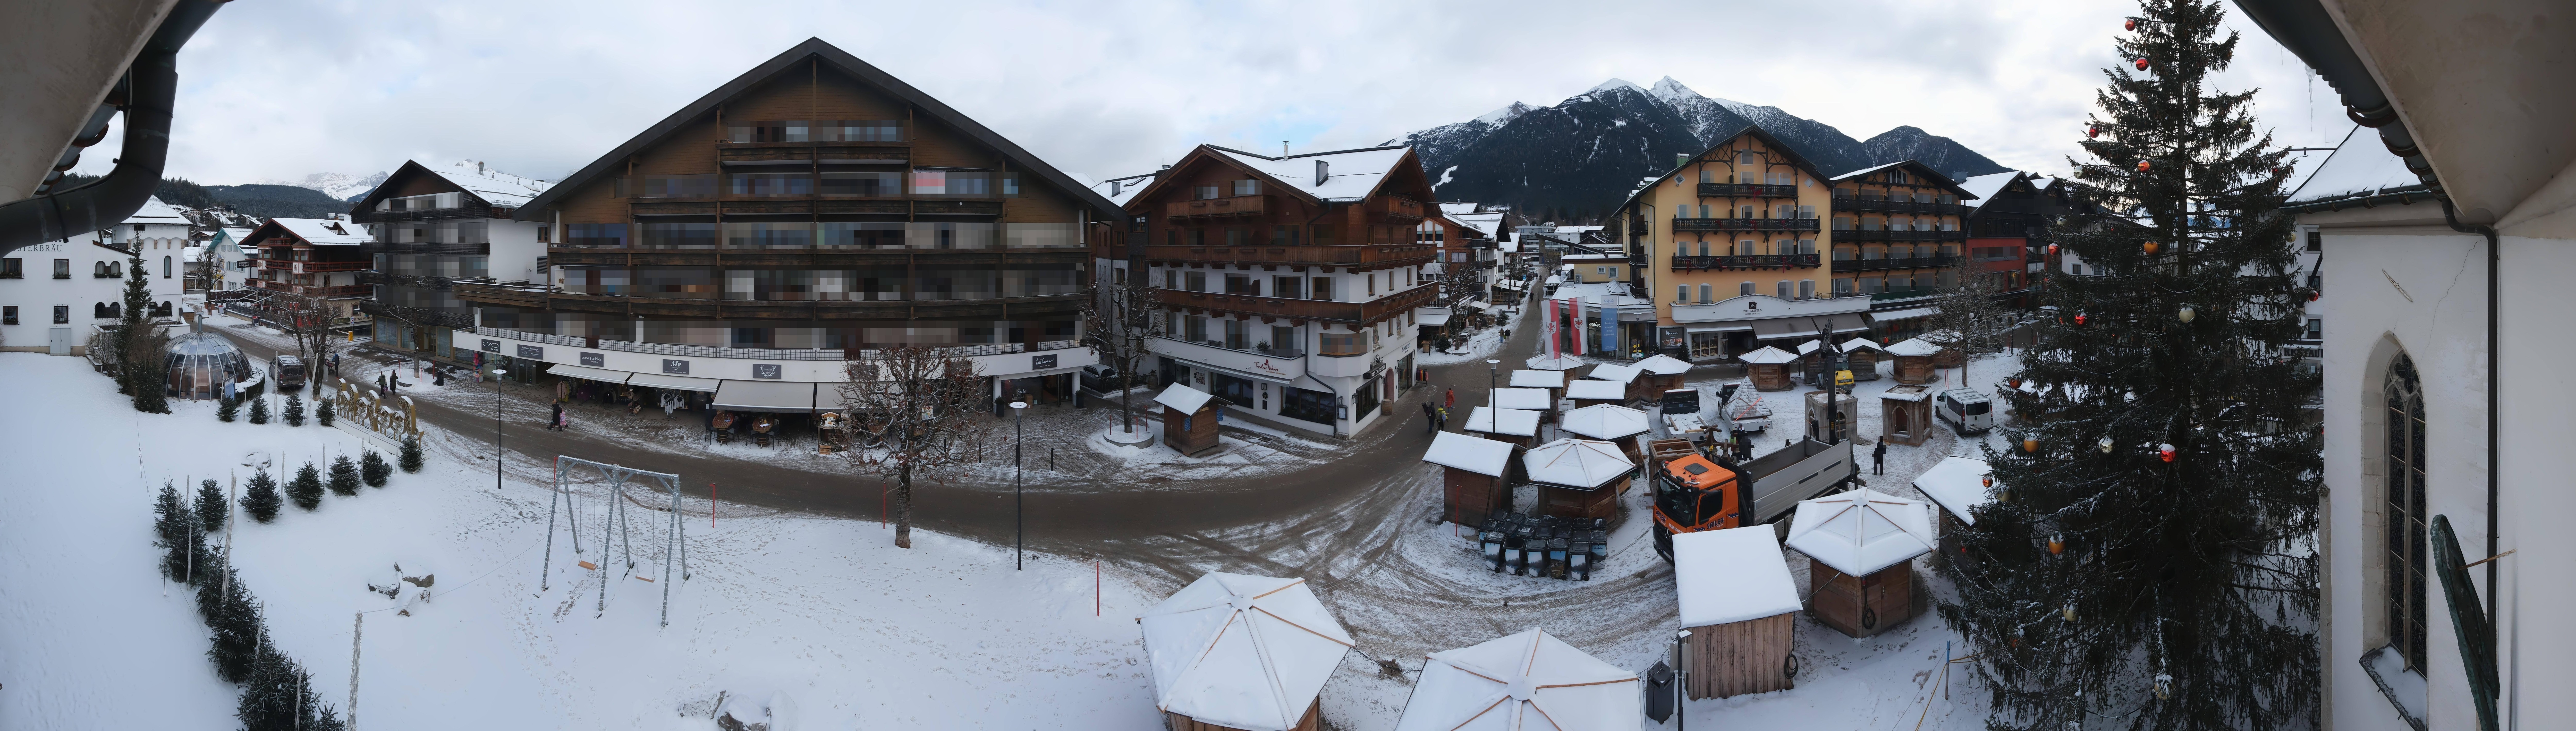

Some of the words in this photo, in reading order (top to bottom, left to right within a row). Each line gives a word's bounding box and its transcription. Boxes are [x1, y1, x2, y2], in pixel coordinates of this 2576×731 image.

[671, 361, 681, 370] My
[1371, 364, 1385, 377] RESTAURANT
[1656, 509, 1666, 524] SAILER
[1707, 517, 1724, 530] SAILER
